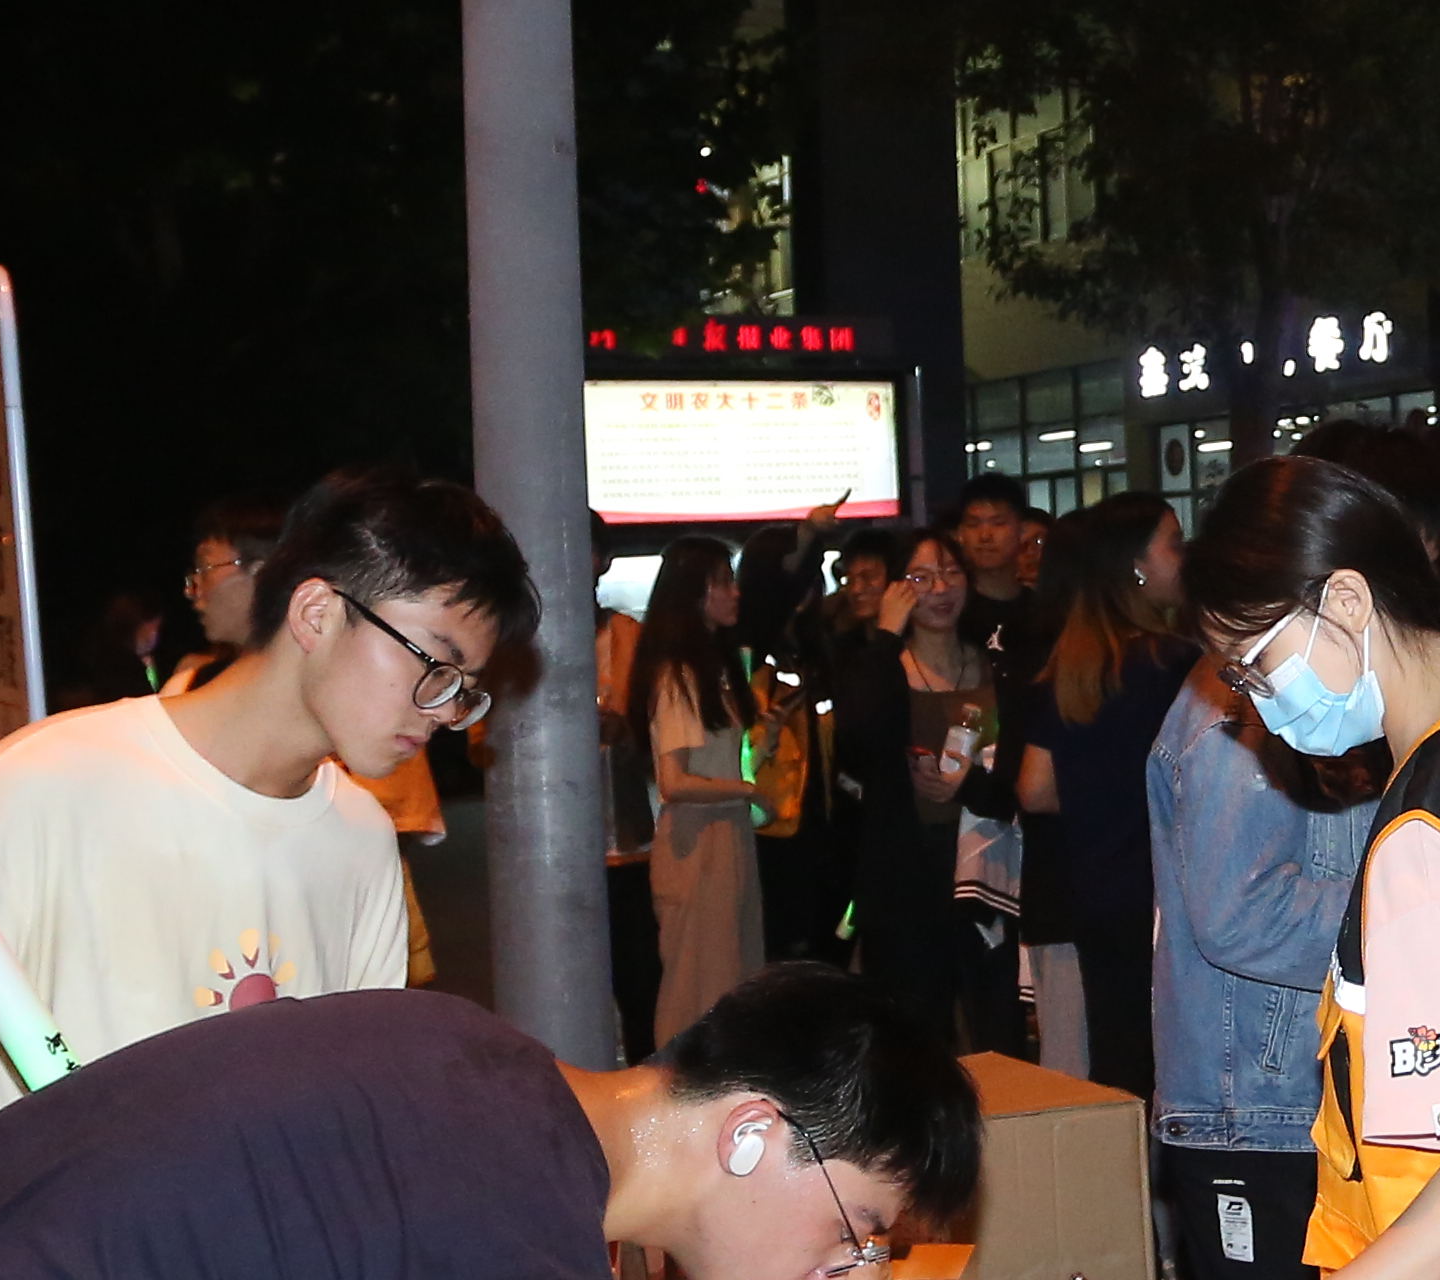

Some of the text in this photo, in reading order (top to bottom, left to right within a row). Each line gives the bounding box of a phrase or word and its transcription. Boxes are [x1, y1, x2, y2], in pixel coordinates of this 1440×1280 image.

[640, 391, 808, 411] 文明农大十二条
